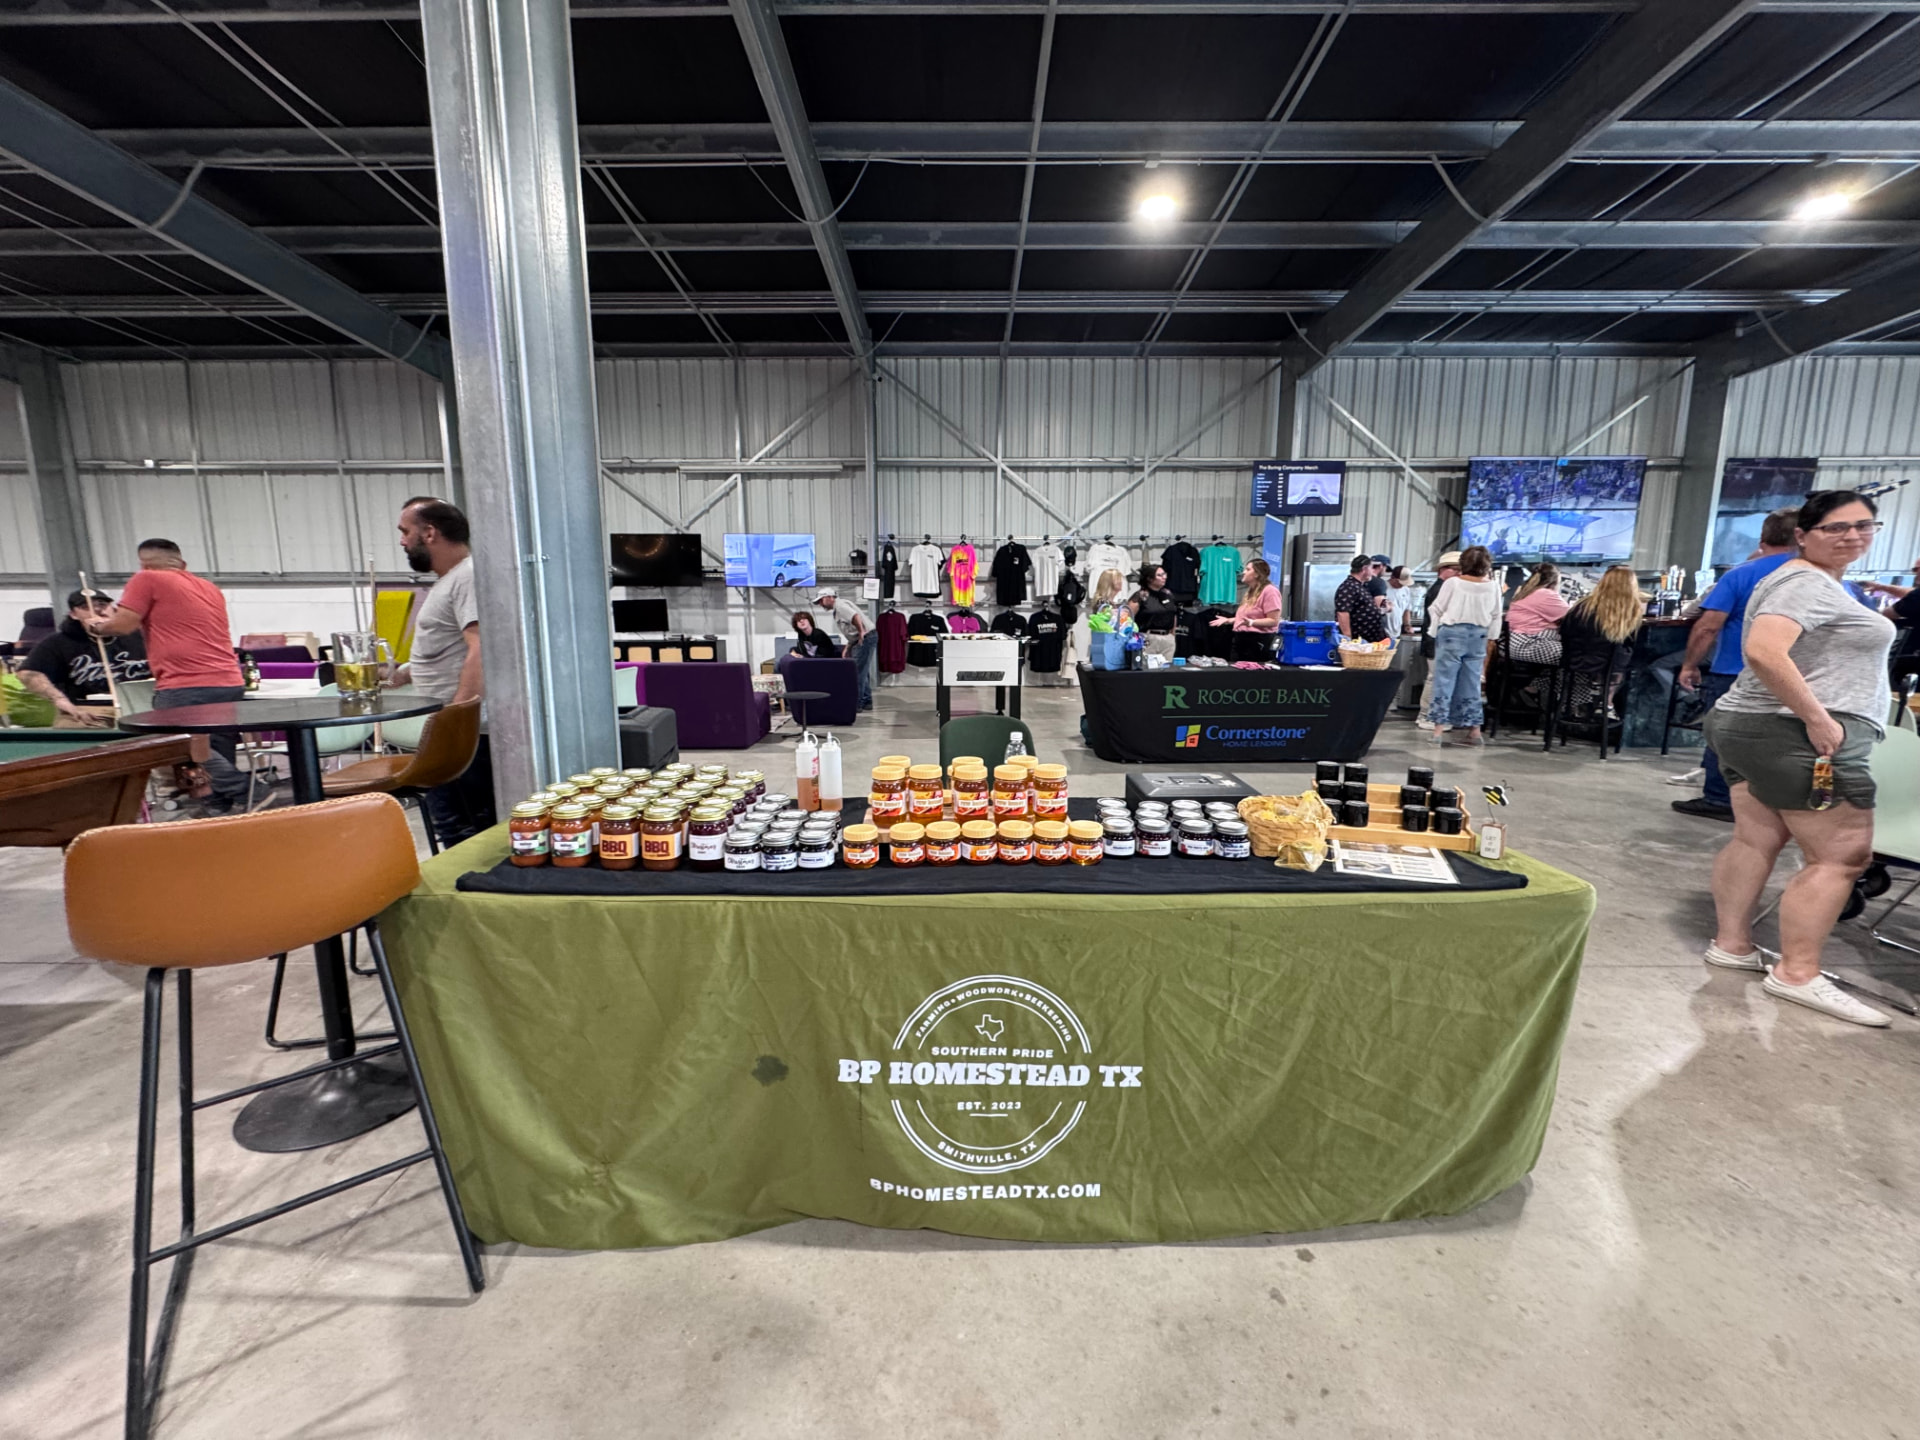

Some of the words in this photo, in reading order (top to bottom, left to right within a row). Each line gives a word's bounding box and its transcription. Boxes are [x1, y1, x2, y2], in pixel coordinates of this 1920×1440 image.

[1197, 688, 1270, 705] ROSCOE
[1276, 688, 1333, 704] BANK
[1206, 725, 1307, 740] Cornerstone
[1222, 740, 1249, 748] HOME
[1250, 740, 1287, 748] LENDING
[602, 840, 628, 853] BBQ
[645, 840, 669, 853] BBQ
[915, 999, 951, 1037] FARMING
[957, 987, 1019, 1001] WOODWORK
[1024, 993, 1072, 1042] BEEKEEPING
[931, 1046, 1007, 1056] SOUTHERN
[1012, 1049, 1054, 1059] PRIDE
[837, 1059, 881, 1084] BP
[888, 1062, 1091, 1087] HOMESTEAD
[1099, 1065, 1143, 1088] TX
[957, 1101, 986, 1111] EST.
[991, 1101, 1021, 1111] 2023
[937, 1141, 1017, 1164] SMITHVILLE,
[1019, 1140, 1038, 1155] TX
[869, 1178, 1101, 1202] BPHOMESTEADTX.COM
